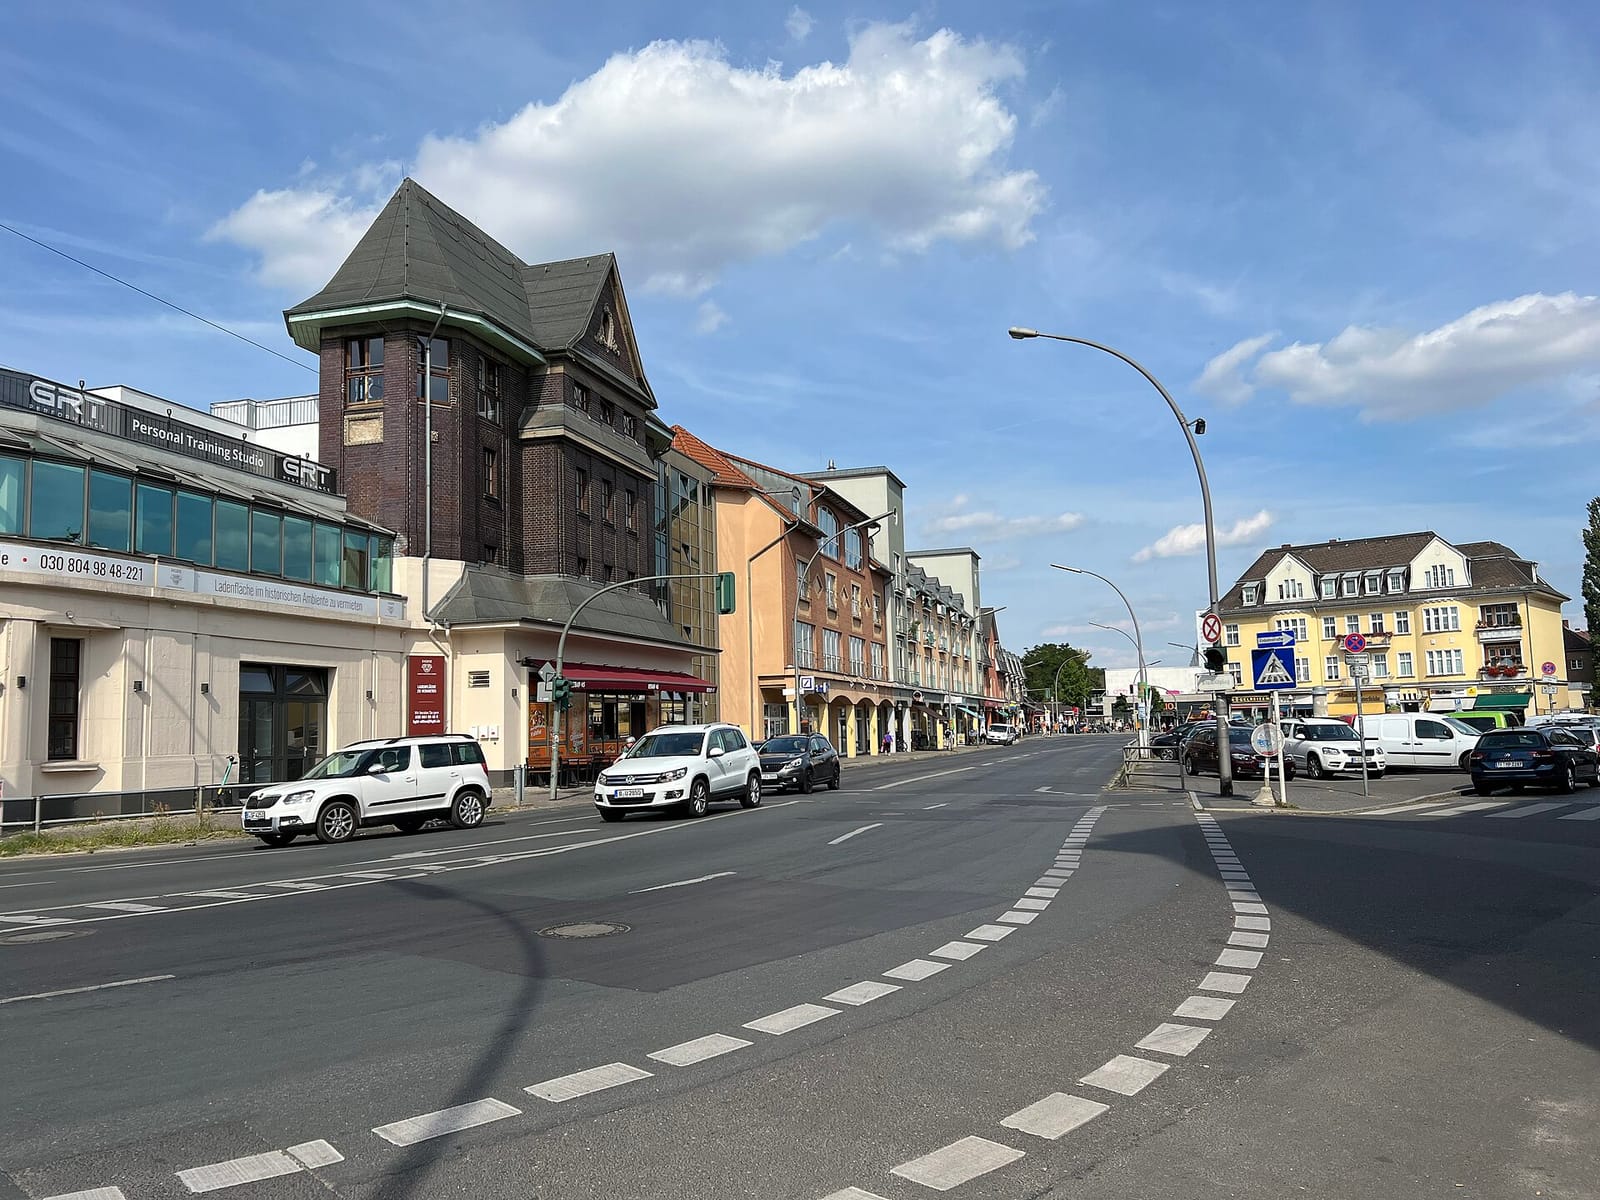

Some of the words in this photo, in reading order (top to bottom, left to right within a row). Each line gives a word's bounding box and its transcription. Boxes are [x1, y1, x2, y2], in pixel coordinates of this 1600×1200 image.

[30, 381, 105, 419] GRT
[132, 419, 183, 445] Personal
[186, 435, 230, 461] Training
[232, 449, 264, 467] Studio
[283, 457, 330, 484] GRT
[40, 554, 64, 571] 030
[68, 557, 90, 574] 804
[93, 562, 106, 576] 98
[109, 564, 143, 581] 48-221
[255, 586, 264, 598] im
[265, 586, 301, 602] historischen
[303, 592, 329, 607] Ambiente
[329, 599, 336, 608] zu
[337, 600, 363, 611] vermieten
[1164, 702, 1174, 710] 10
